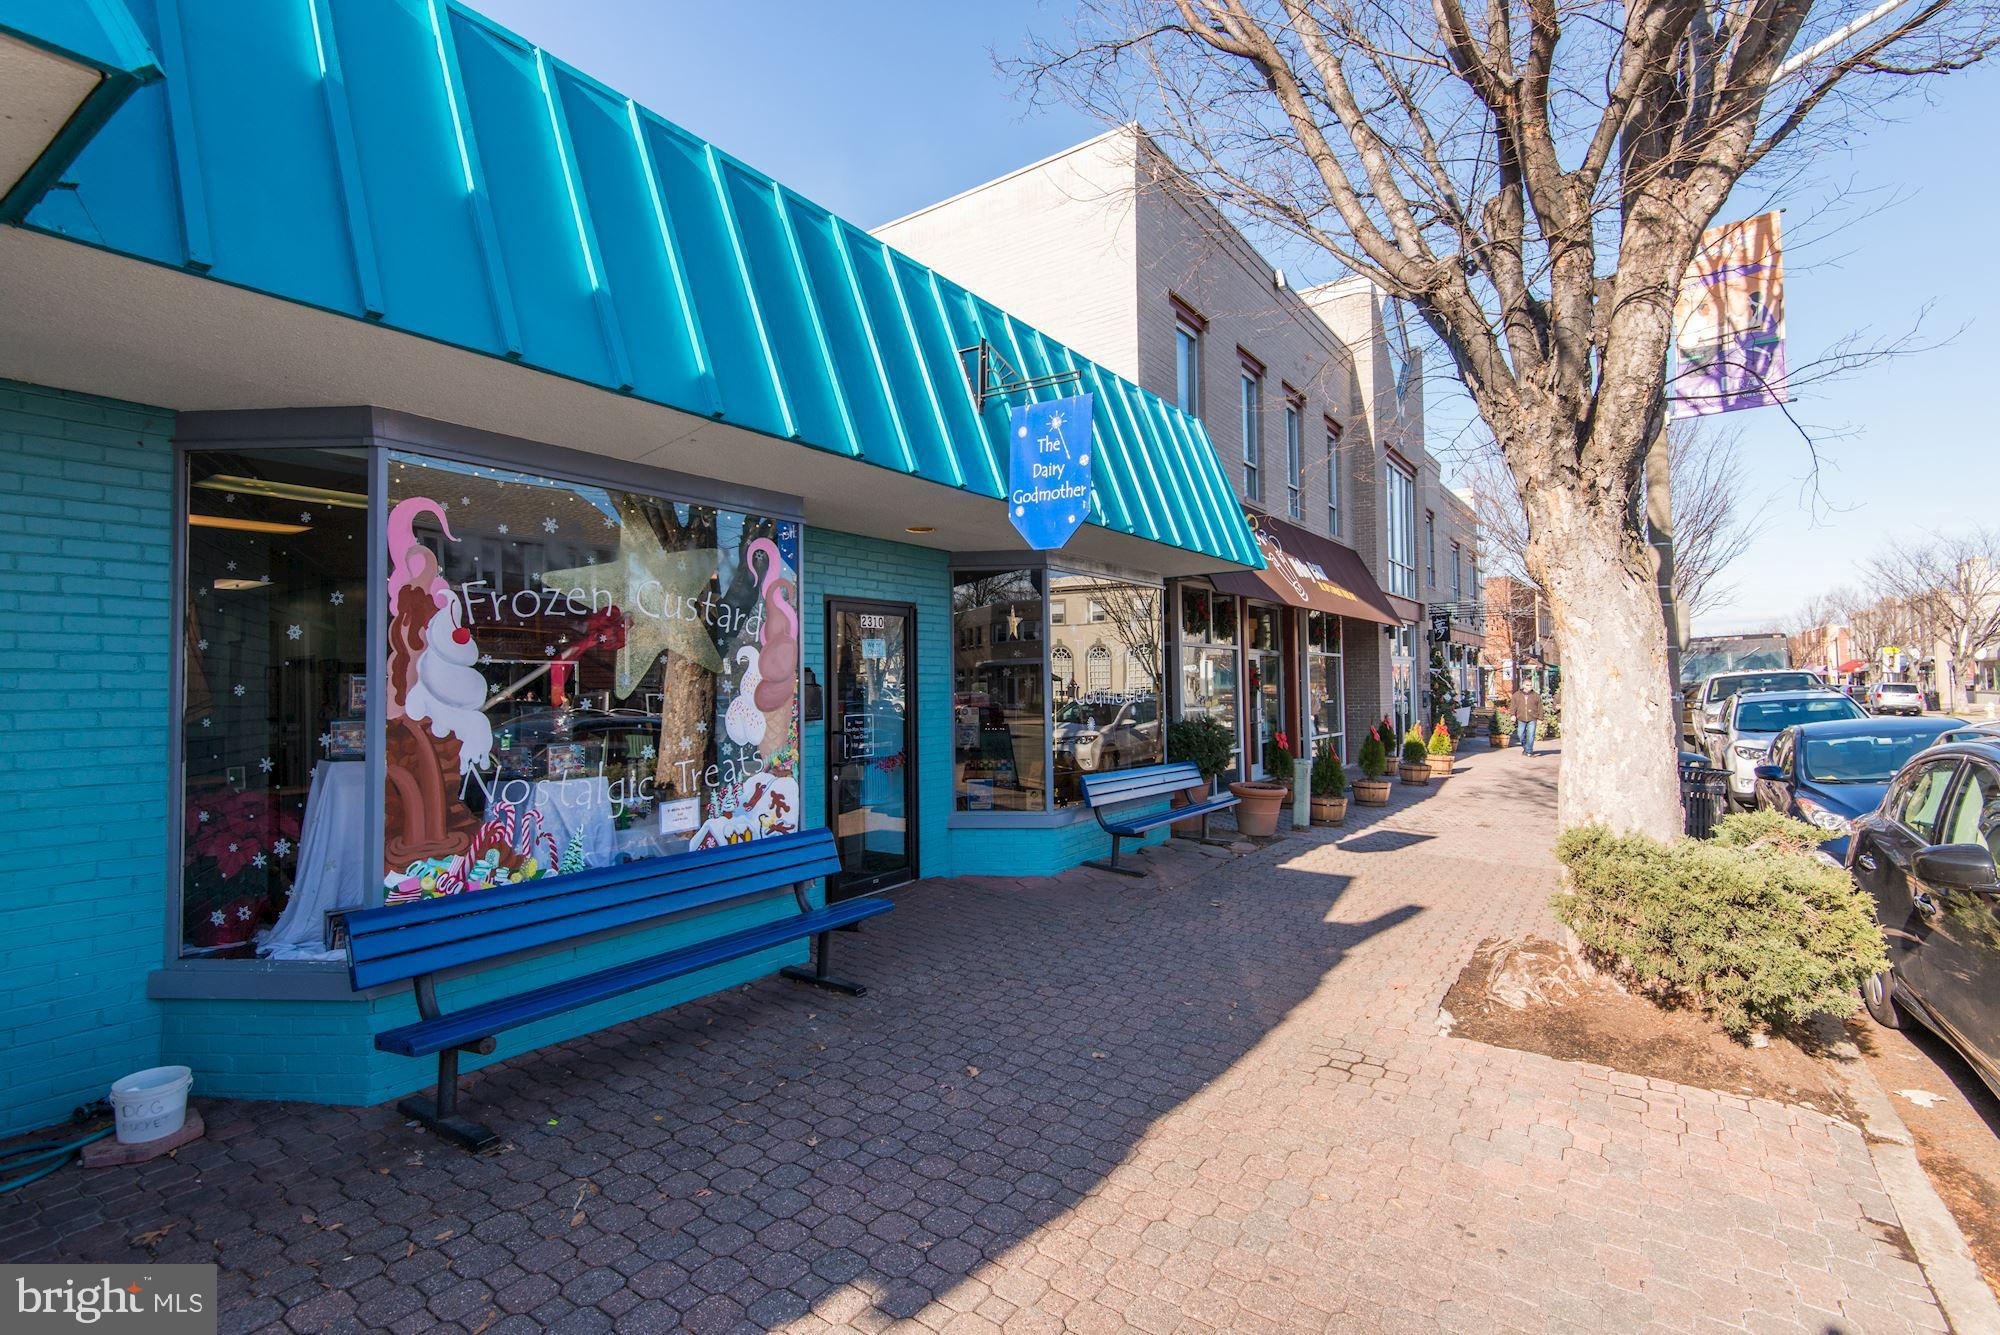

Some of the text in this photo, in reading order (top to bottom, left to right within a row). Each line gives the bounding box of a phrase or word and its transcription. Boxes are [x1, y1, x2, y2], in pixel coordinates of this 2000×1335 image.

[1037, 435, 1060, 453] The
[1033, 463, 1065, 480] Dairy
[1013, 481, 1086, 504] Godmother
[461, 579, 763, 642] Frozen Custard
[862, 616, 883, 628] 2310
[458, 747, 765, 819] Nostalgic Treats
[122, 1100, 164, 1118] DOG
